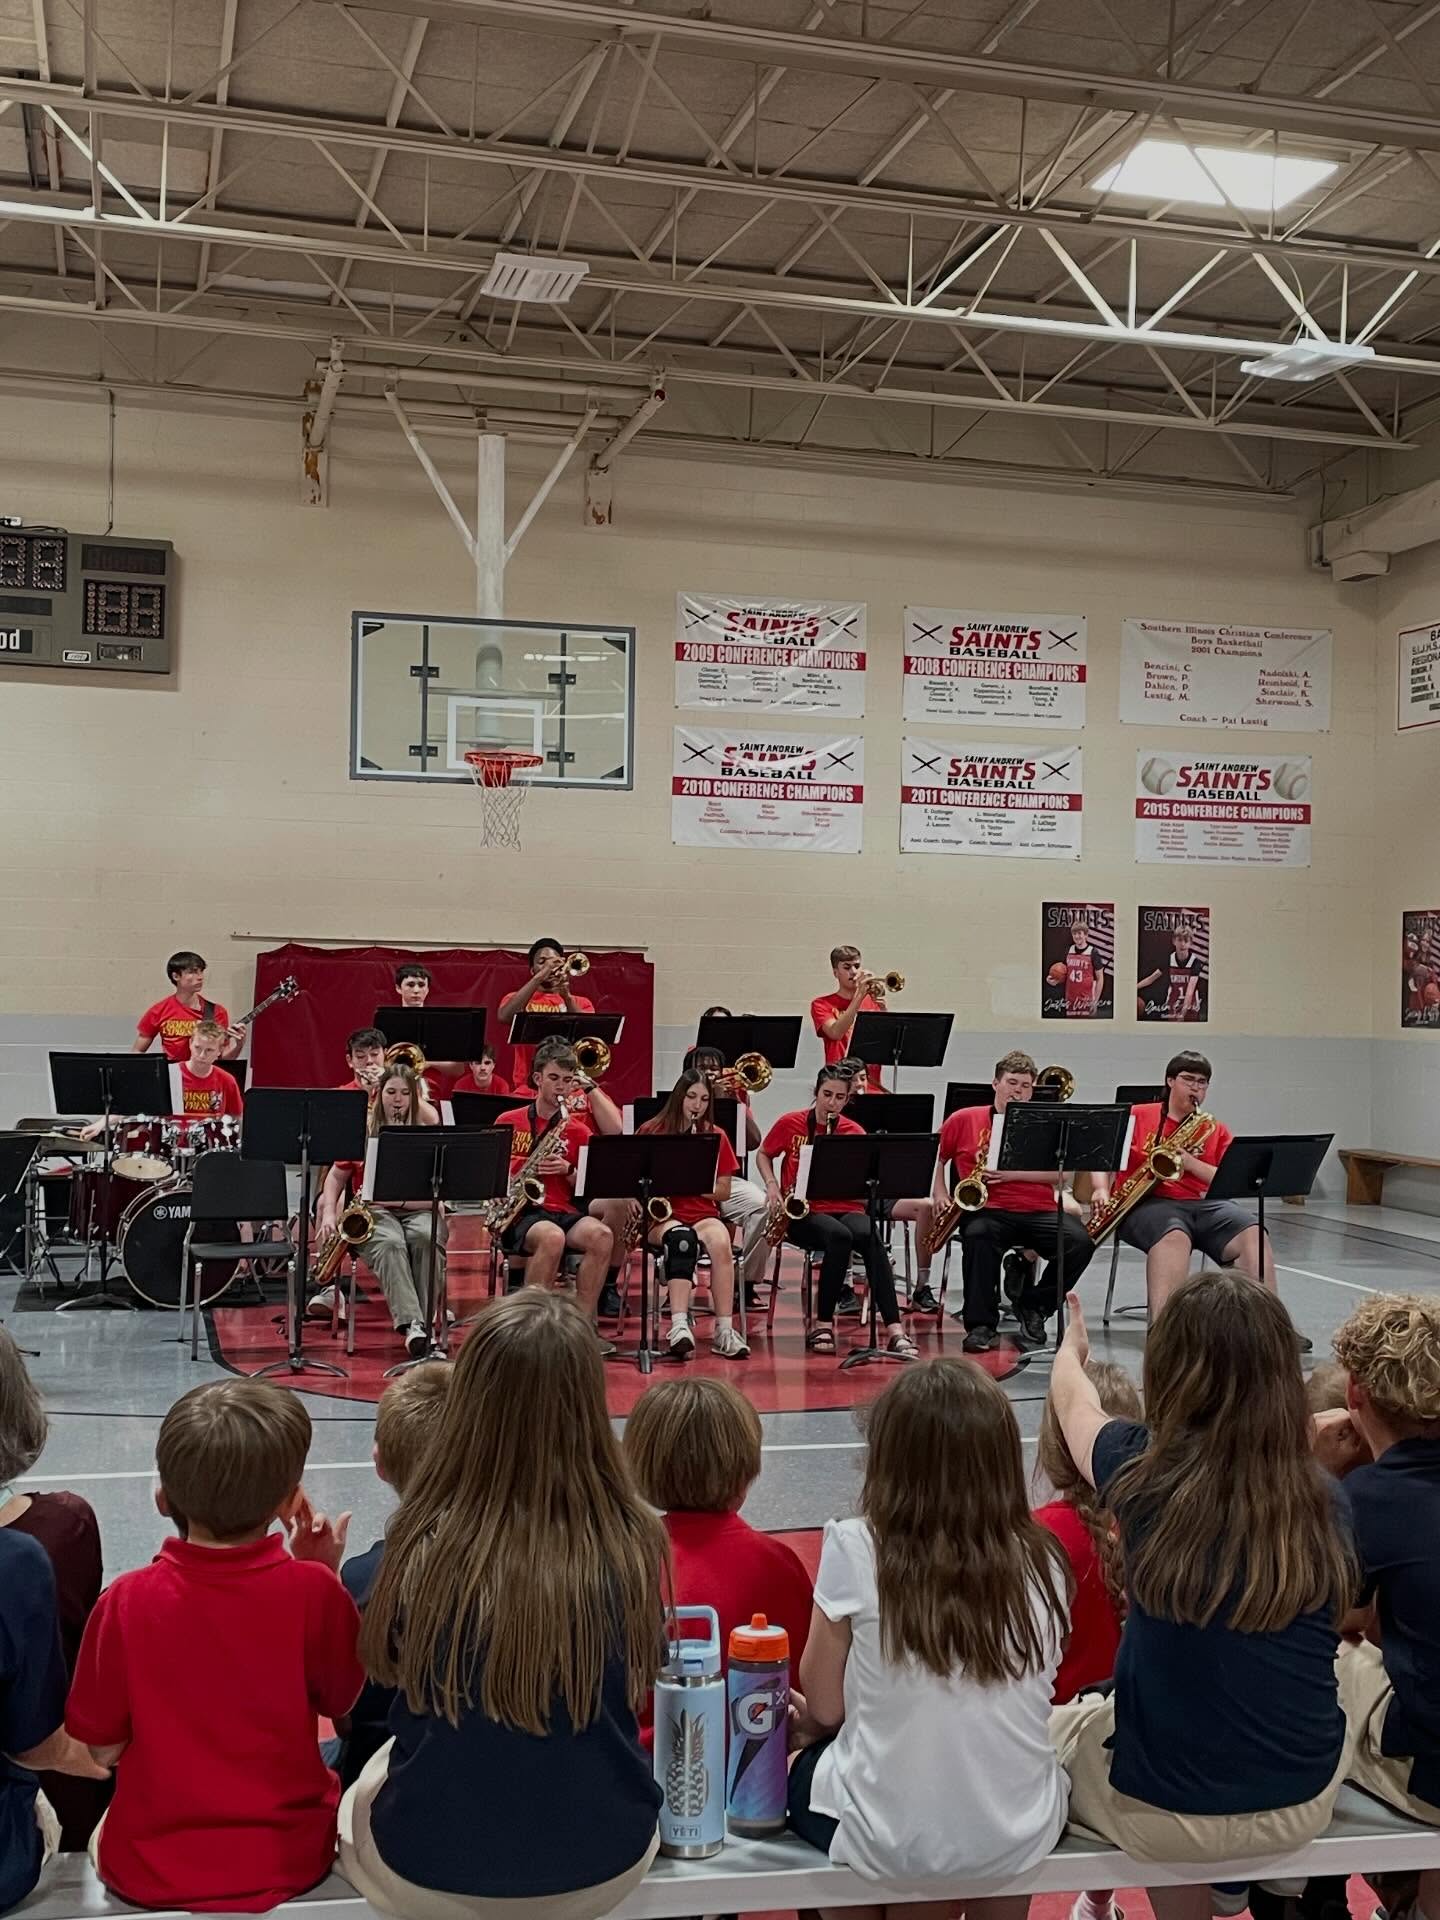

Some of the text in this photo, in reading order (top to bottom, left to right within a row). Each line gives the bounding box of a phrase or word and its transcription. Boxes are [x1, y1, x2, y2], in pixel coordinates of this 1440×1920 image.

[724, 612, 819, 637] SAINTS
[966, 622, 1030, 633] SAINT ANDREW
[1140, 622, 1312, 640] Southern Illinois Christian Conference
[950, 626, 1042, 650] SAINTS
[1191, 636, 1262, 648] Boys Basketball
[683, 643, 858, 670] 2009 CONFERENCE CHAMPIONS
[950, 647, 1041, 659] BASEBALL
[1191, 646, 1262, 658] 2001 Champions
[910, 657, 1078, 682] 2008 CONFERENCE CHAMPIONS
[1180, 714, 1208, 722] Coach
[1222, 716, 1236, 724] Pat
[740, 743, 804, 754] SAINT ANDREW
[964, 755, 1025, 765] SAINT ANDREW
[948, 758, 1036, 781] SAINTS
[1194, 762, 1259, 772] SAINT ANDREW
[722, 768, 816, 780] BASEBALL
[1176, 766, 1272, 791] SAINTS
[682, 779, 854, 802] 2010 CONFERENCE CHAMPIONS
[947, 778, 1036, 790] BASEBALL
[912, 788, 1070, 810] 2011 CONFERENCE CHAMPIONS
[1188, 788, 1261, 800] BASEBALL
[1144, 802, 1304, 820] 2015 CONFERENCE CHAMPIONS
[1048, 907, 1110, 928] SAINTS
[1144, 910, 1204, 930] SAINTS
[1069, 970, 1083, 984] 43
[168, 1206, 192, 1218] YAM
[672, 1826, 698, 1836] YETI
